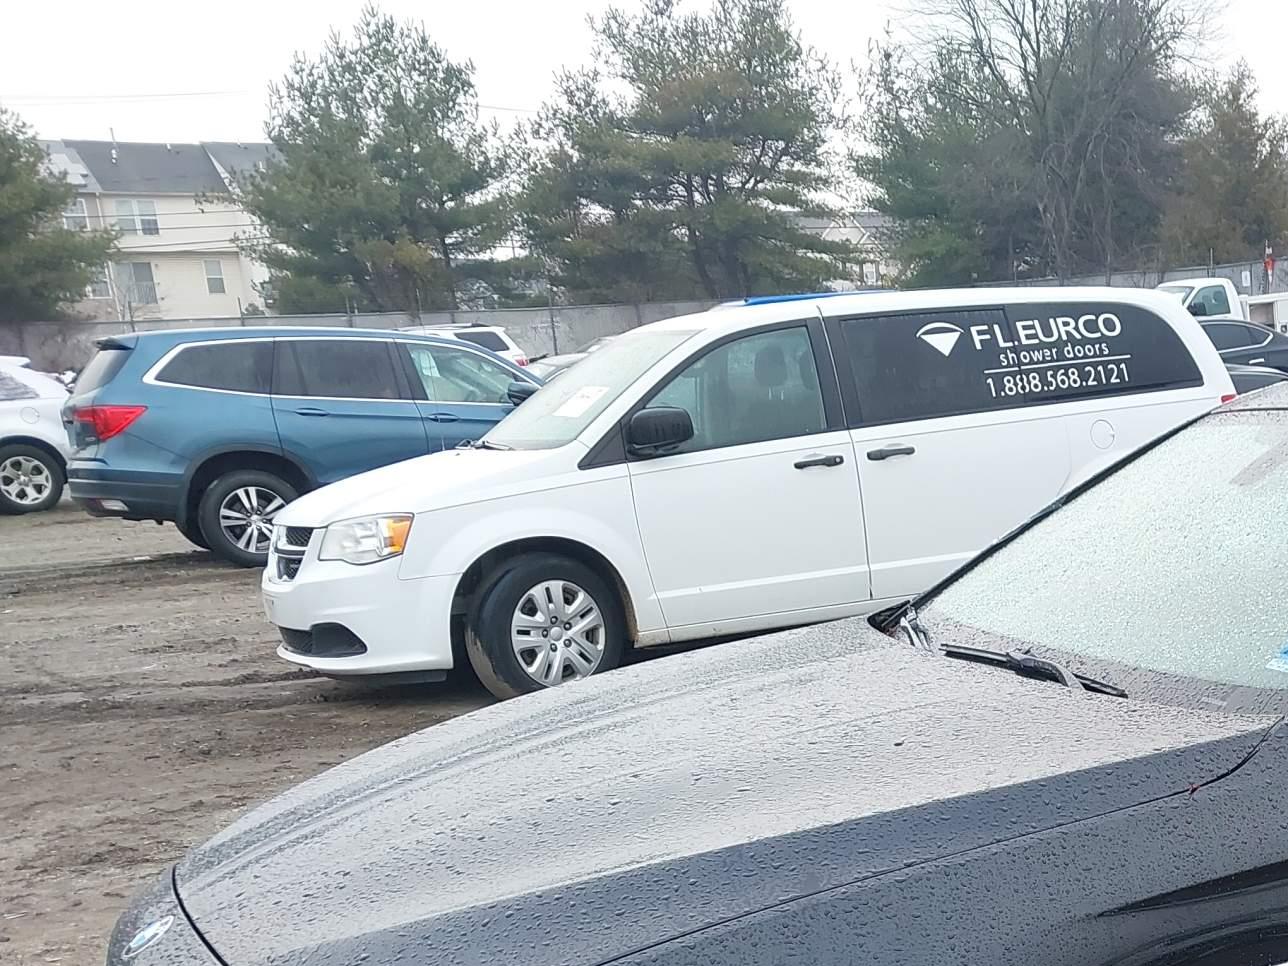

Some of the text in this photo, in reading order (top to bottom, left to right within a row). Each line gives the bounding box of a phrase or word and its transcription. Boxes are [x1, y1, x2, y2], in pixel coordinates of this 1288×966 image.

[969, 313, 1122, 350] FLEURCO
[1000, 342, 1110, 367] shower doors
[986, 362, 1130, 398] 1.888.568.2121
